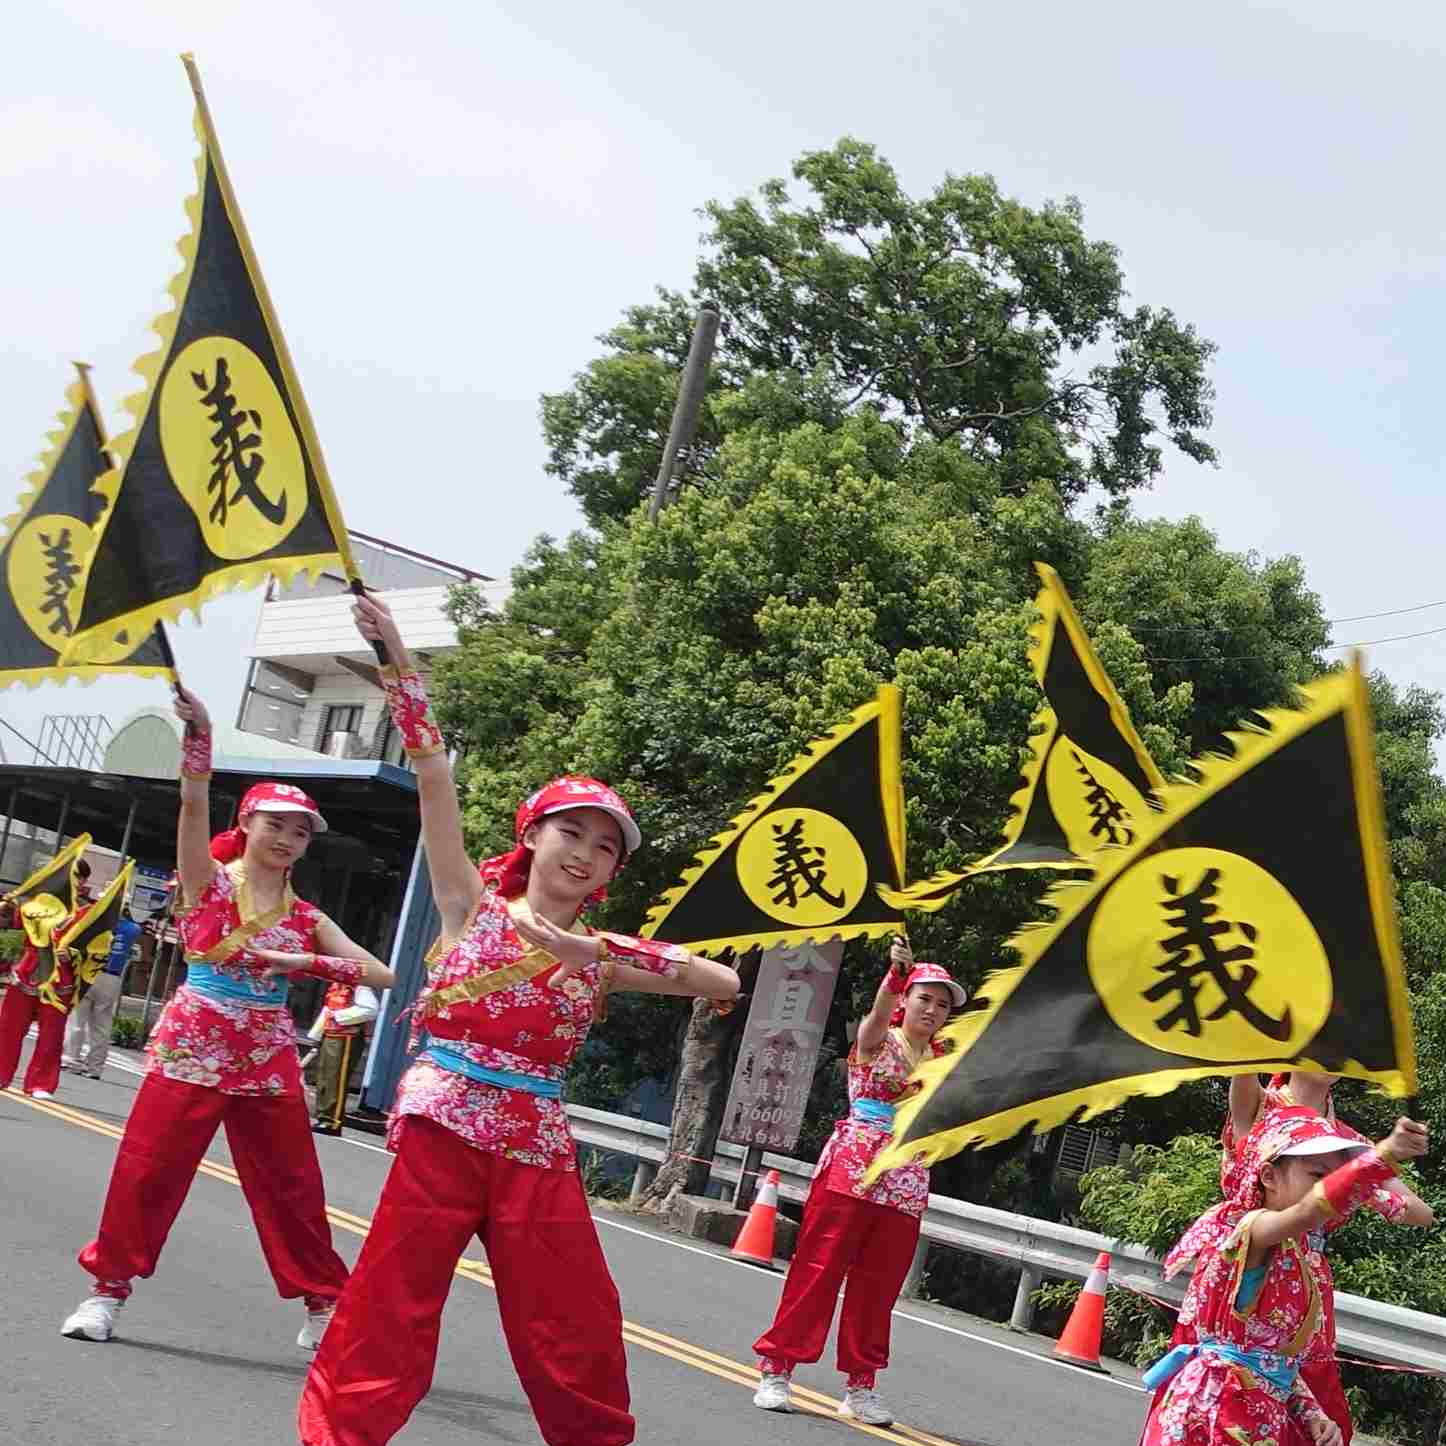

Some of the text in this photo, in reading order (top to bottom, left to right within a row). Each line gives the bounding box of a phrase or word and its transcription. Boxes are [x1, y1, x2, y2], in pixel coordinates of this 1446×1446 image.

[191, 357, 287, 527] 義
[39, 528, 82, 638] 義
[766, 818, 846, 909] 義
[1141, 867, 1293, 1043] 義
